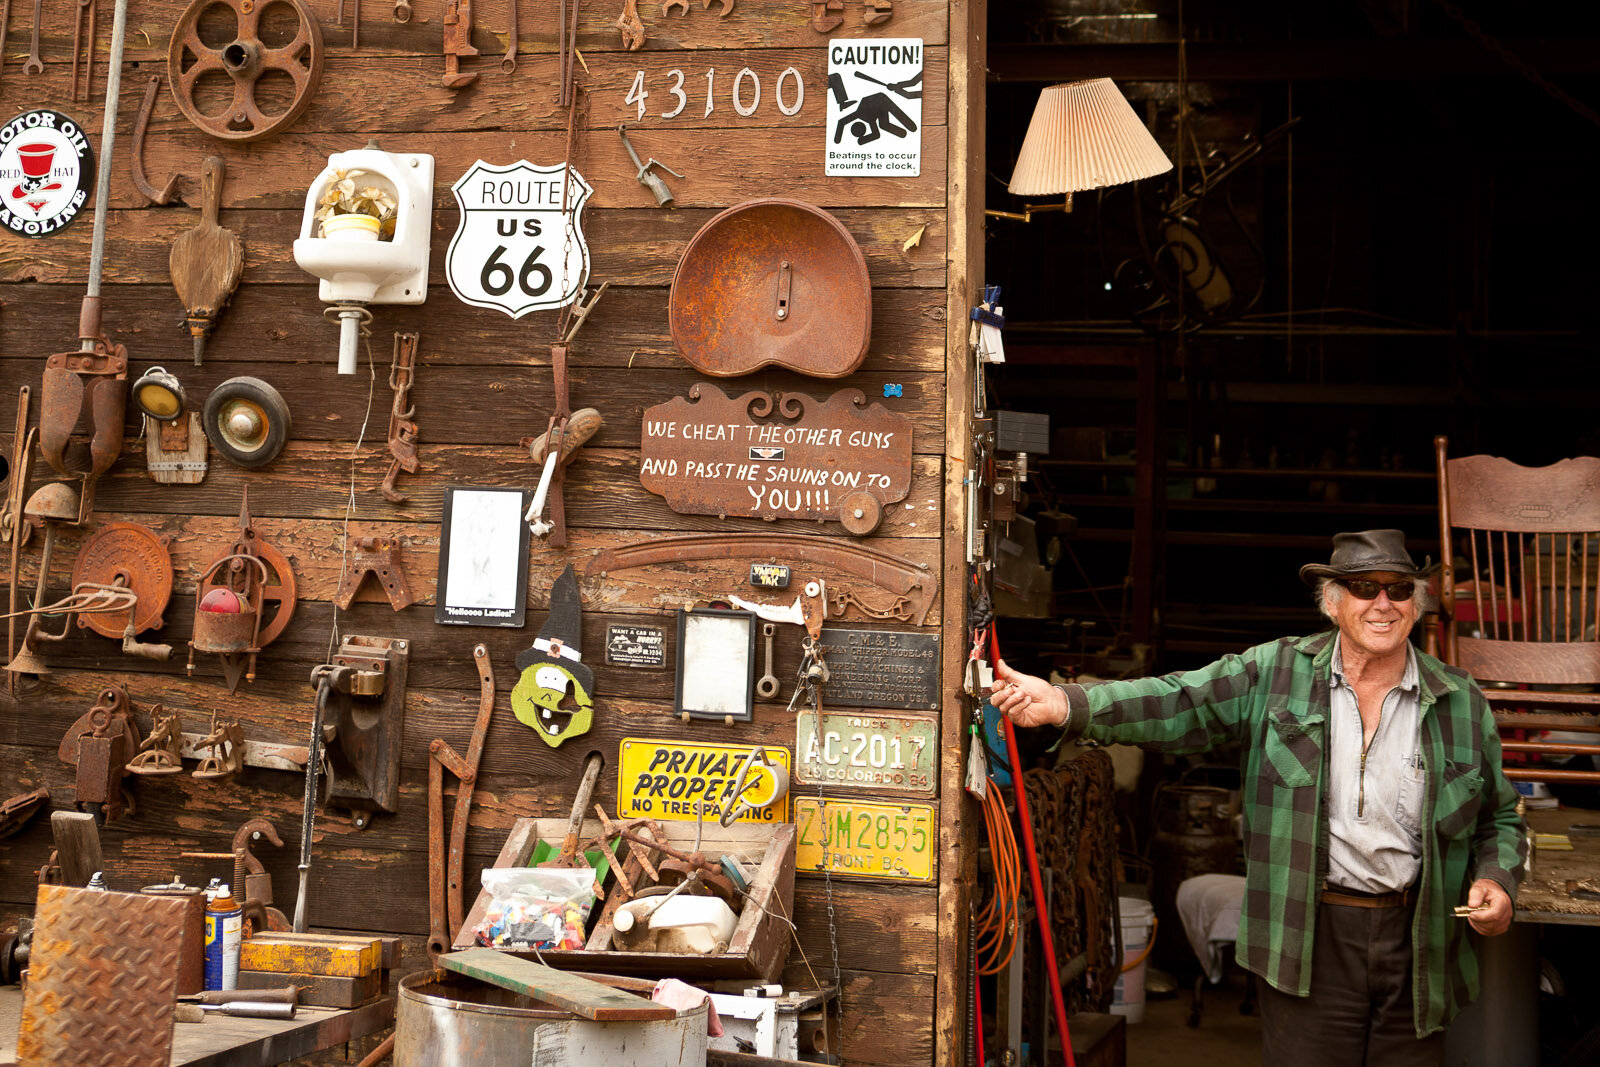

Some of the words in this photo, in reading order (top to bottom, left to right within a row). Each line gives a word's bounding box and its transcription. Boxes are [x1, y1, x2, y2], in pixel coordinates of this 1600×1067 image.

[831, 46, 920, 65] CAUTION!
[624, 67, 805, 122] 43100
[0, 112, 56, 150] OTOR
[61, 121, 88, 158] OIL
[829, 151, 872, 161] Beatings
[0, 169, 21, 179] RED
[54, 167, 75, 177] HAT
[829, 162, 863, 170] around
[866, 162, 883, 170] the
[886, 162, 916, 170] clock.
[482, 181, 562, 205] ROUTE
[0, 189, 86, 234] ASOLINE
[497, 218, 542, 237] US
[480, 244, 553, 297] 66
[647, 420, 677, 439] WE
[682, 423, 740, 442] CHEAT
[848, 430, 894, 450] GUYS
[640, 458, 678, 476] AND
[867, 473, 891, 489] TO
[747, 484, 830, 512] YOU!!!
[851, 646, 890, 657] CHIPPER
[890, 648, 920, 658] MODEL
[921, 650, 934, 658] 48
[828, 661, 858, 672] IPPER
[863, 664, 914, 674] MACHINES
[918, 666, 925, 674] &
[830, 672, 889, 683] NGINEERING
[820, 690, 863, 699] ORTLAND
[868, 692, 905, 702] OREGON
[910, 694, 929, 703] USA
[848, 718, 888, 730] TRUCK
[649, 749, 761, 777] PRIVAT
[826, 769, 904, 784] COLORADO
[633, 773, 741, 802] PROPER
[632, 798, 653, 812] NO
[882, 857, 904, 871] BC
